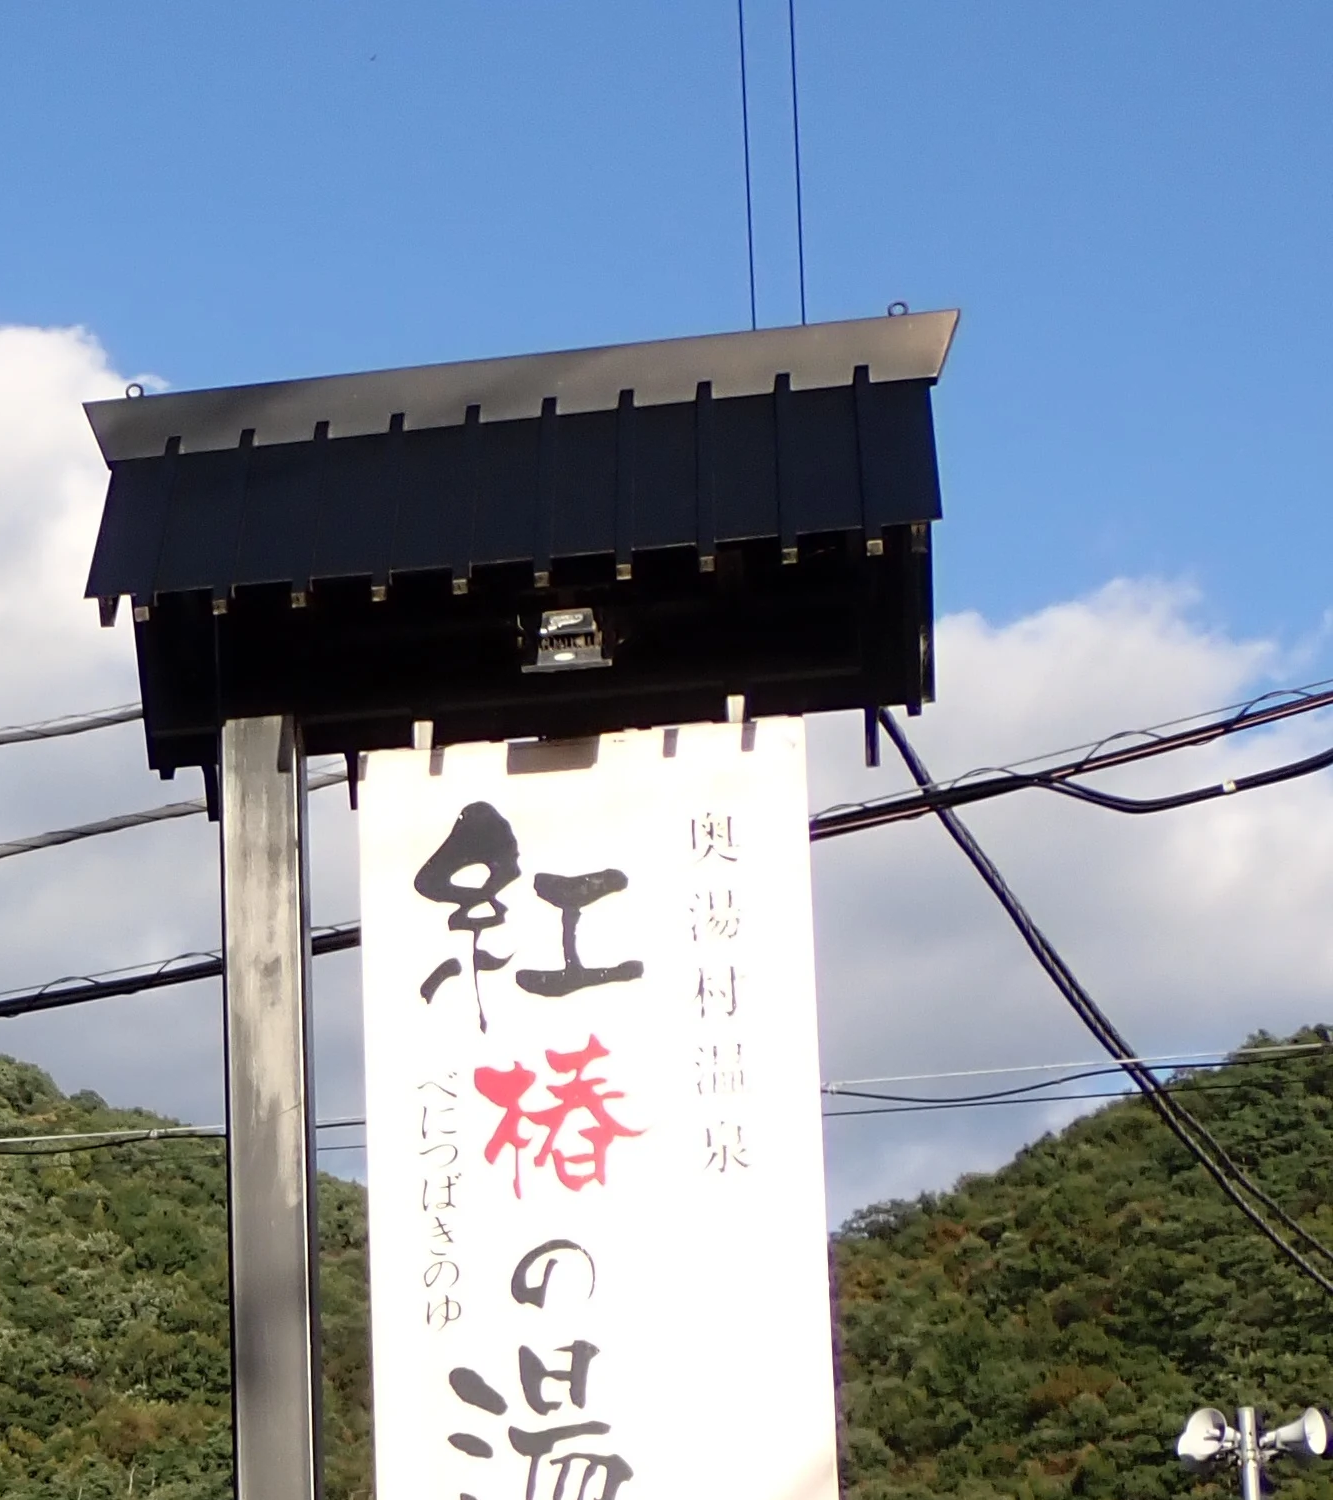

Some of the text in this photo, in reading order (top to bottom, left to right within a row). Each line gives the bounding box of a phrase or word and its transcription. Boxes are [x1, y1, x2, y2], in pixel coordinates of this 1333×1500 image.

[689, 811, 753, 1174] 奥湯村温泉
[416, 1071, 463, 1332] べにつばきのゆ
